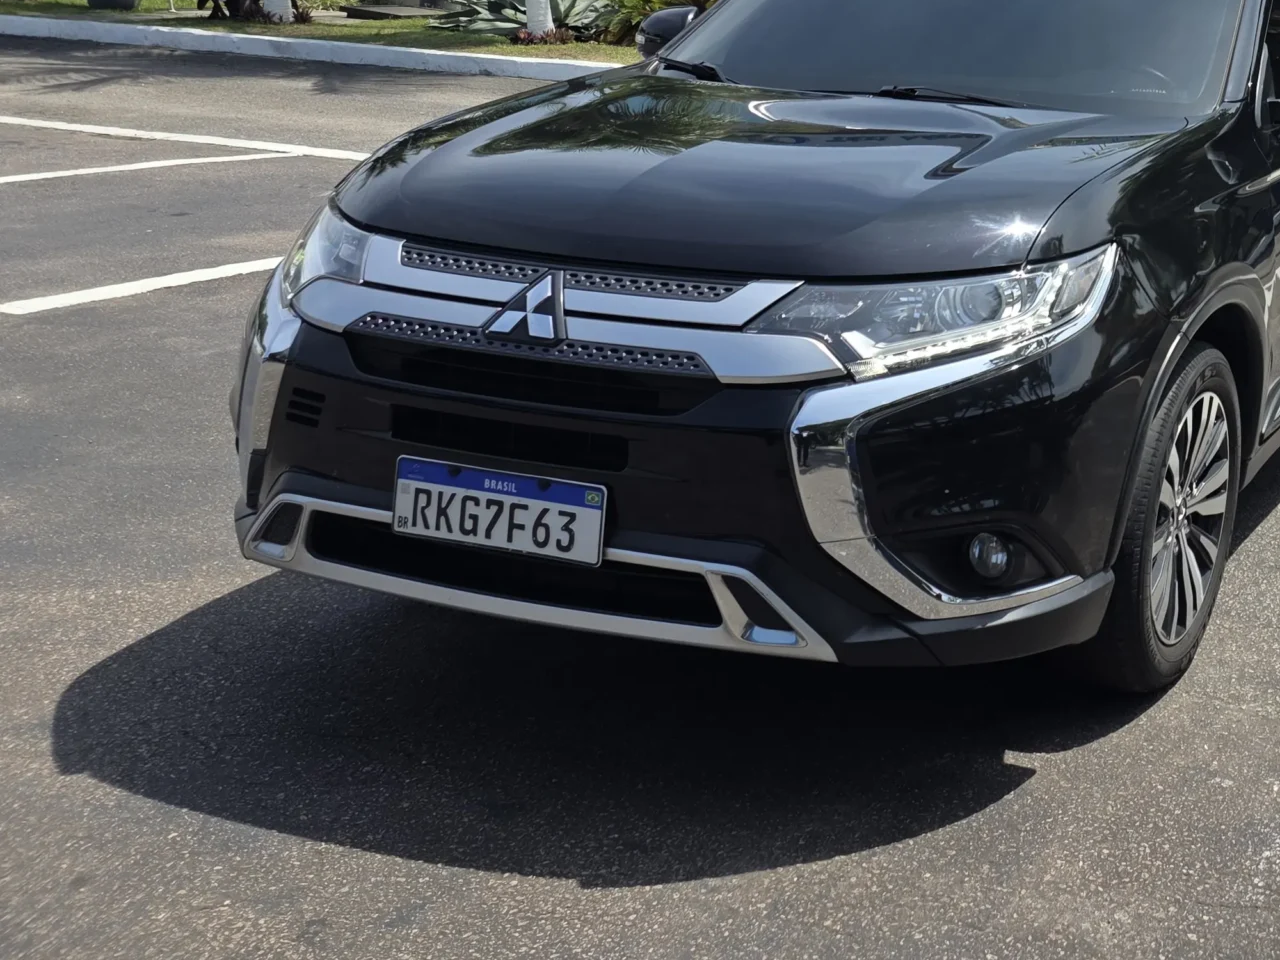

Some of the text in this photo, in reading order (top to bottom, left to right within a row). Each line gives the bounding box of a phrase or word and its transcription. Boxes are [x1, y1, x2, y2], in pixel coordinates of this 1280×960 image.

[484, 478, 517, 493] BRASIL
[397, 487, 577, 553] BR RKG7F63
